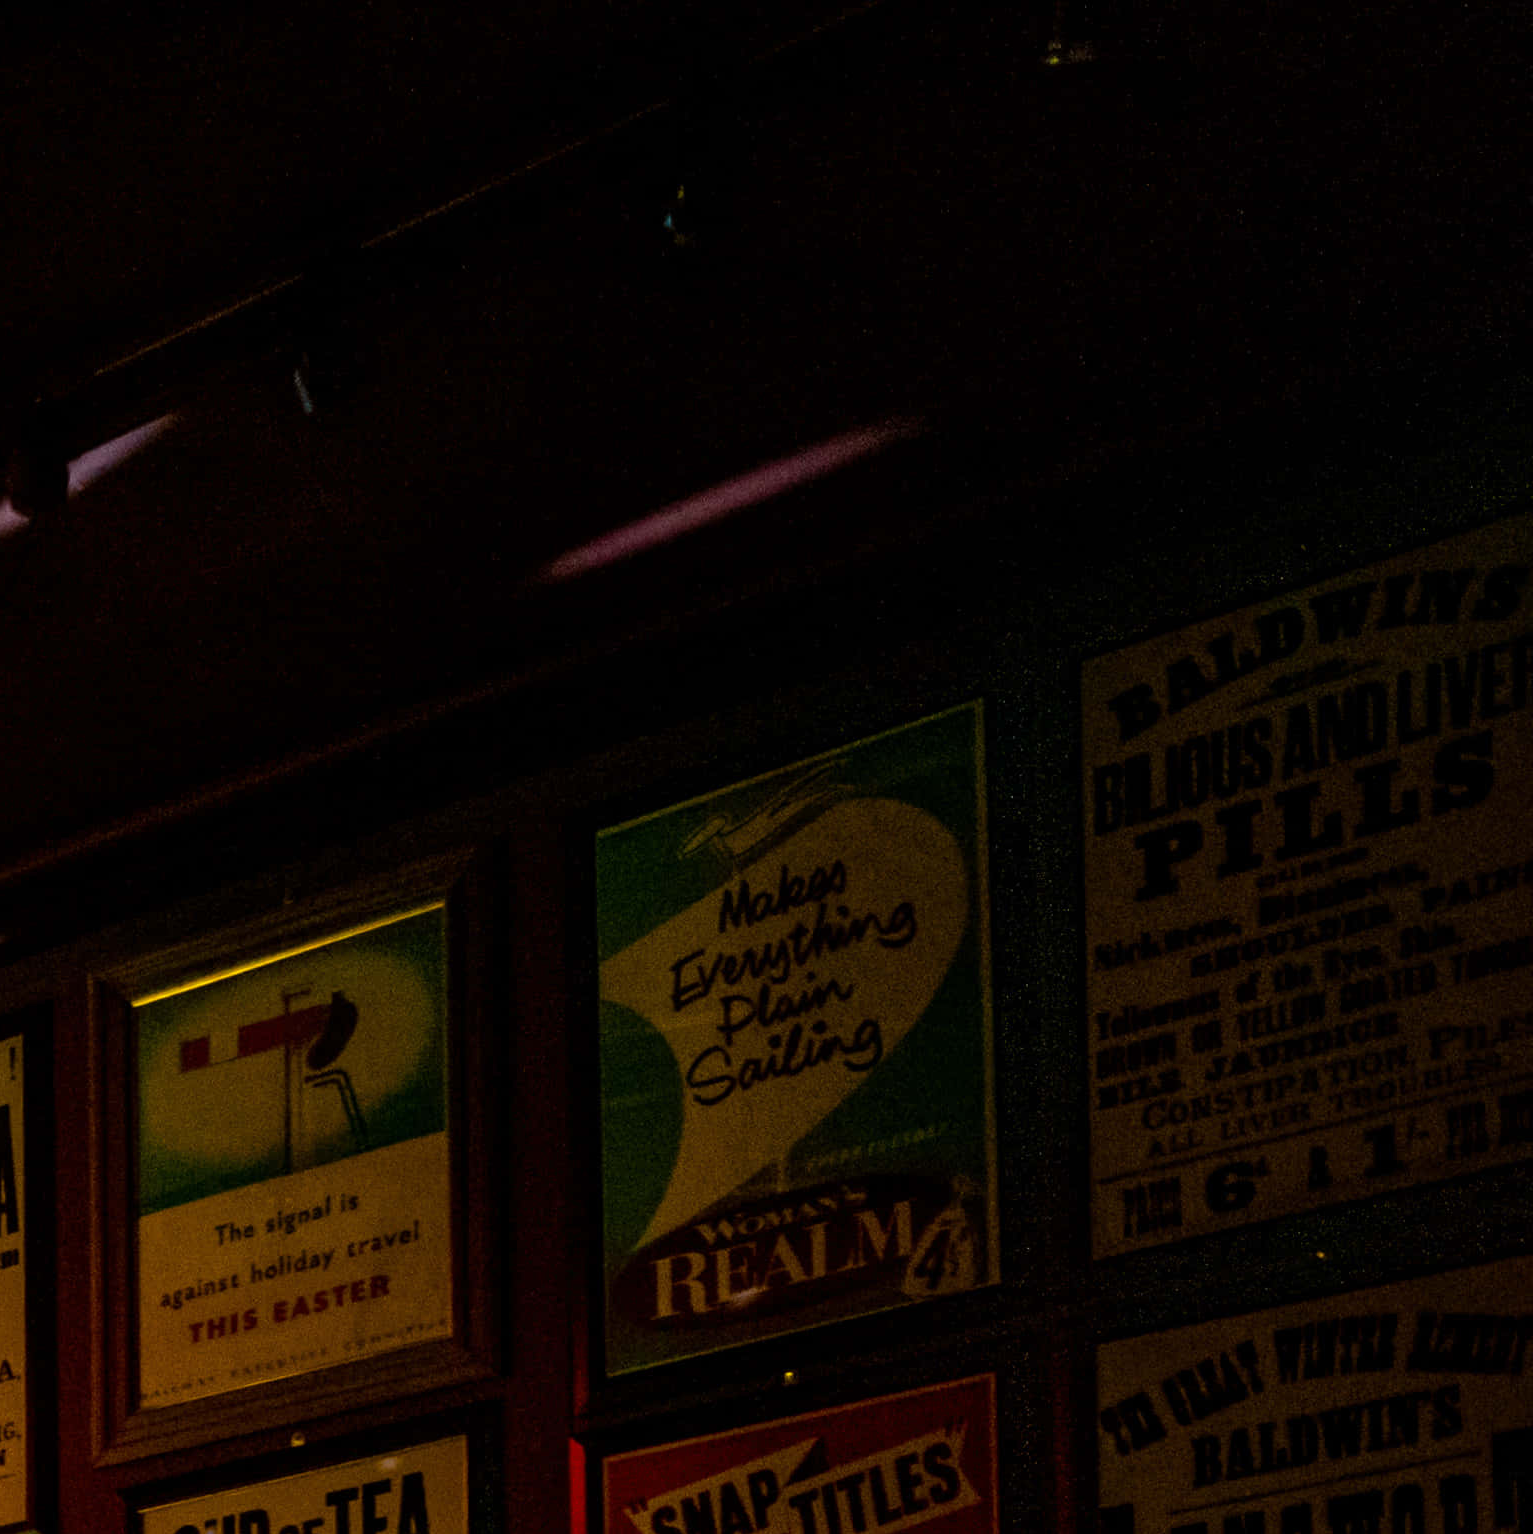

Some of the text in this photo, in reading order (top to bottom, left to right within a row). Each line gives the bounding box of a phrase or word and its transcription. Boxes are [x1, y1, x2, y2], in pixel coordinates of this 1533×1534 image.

[1094, 715, 1273, 836] BILIOUS
[1283, 680, 1388, 780] AND
[1135, 731, 1494, 901] PILLS
[719, 860, 847, 933] Makes
[671, 901, 916, 1012] Everything
[716, 971, 853, 1045] Plain
[686, 1016, 882, 1105] Sailing
[1222, 1102, 1310, 1140] LIVER
[215, 1192, 359, 1247] The signal is
[649, 1199, 914, 1324] REALM
[160, 1220, 420, 1310] against holiday travel
[188, 1273, 391, 1344] THIS EASTER
[1190, 1384, 1463, 1488] BALDWIN'S
